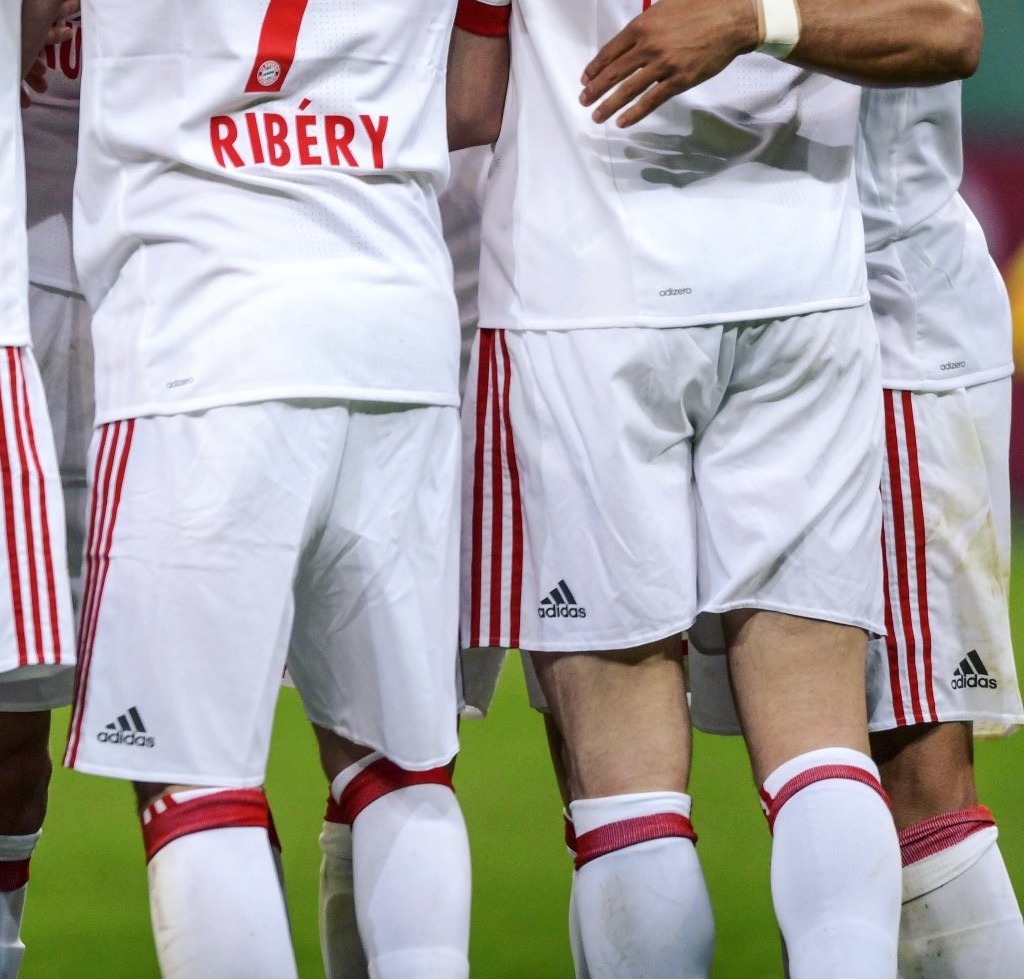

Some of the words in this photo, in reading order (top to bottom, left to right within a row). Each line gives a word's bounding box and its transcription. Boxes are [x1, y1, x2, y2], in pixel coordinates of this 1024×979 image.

[209, 98, 389, 170] RIBÉRY
[537, 603, 587, 619] adidas
[950, 673, 998, 690] adidas
[96, 730, 156, 749] adidas
